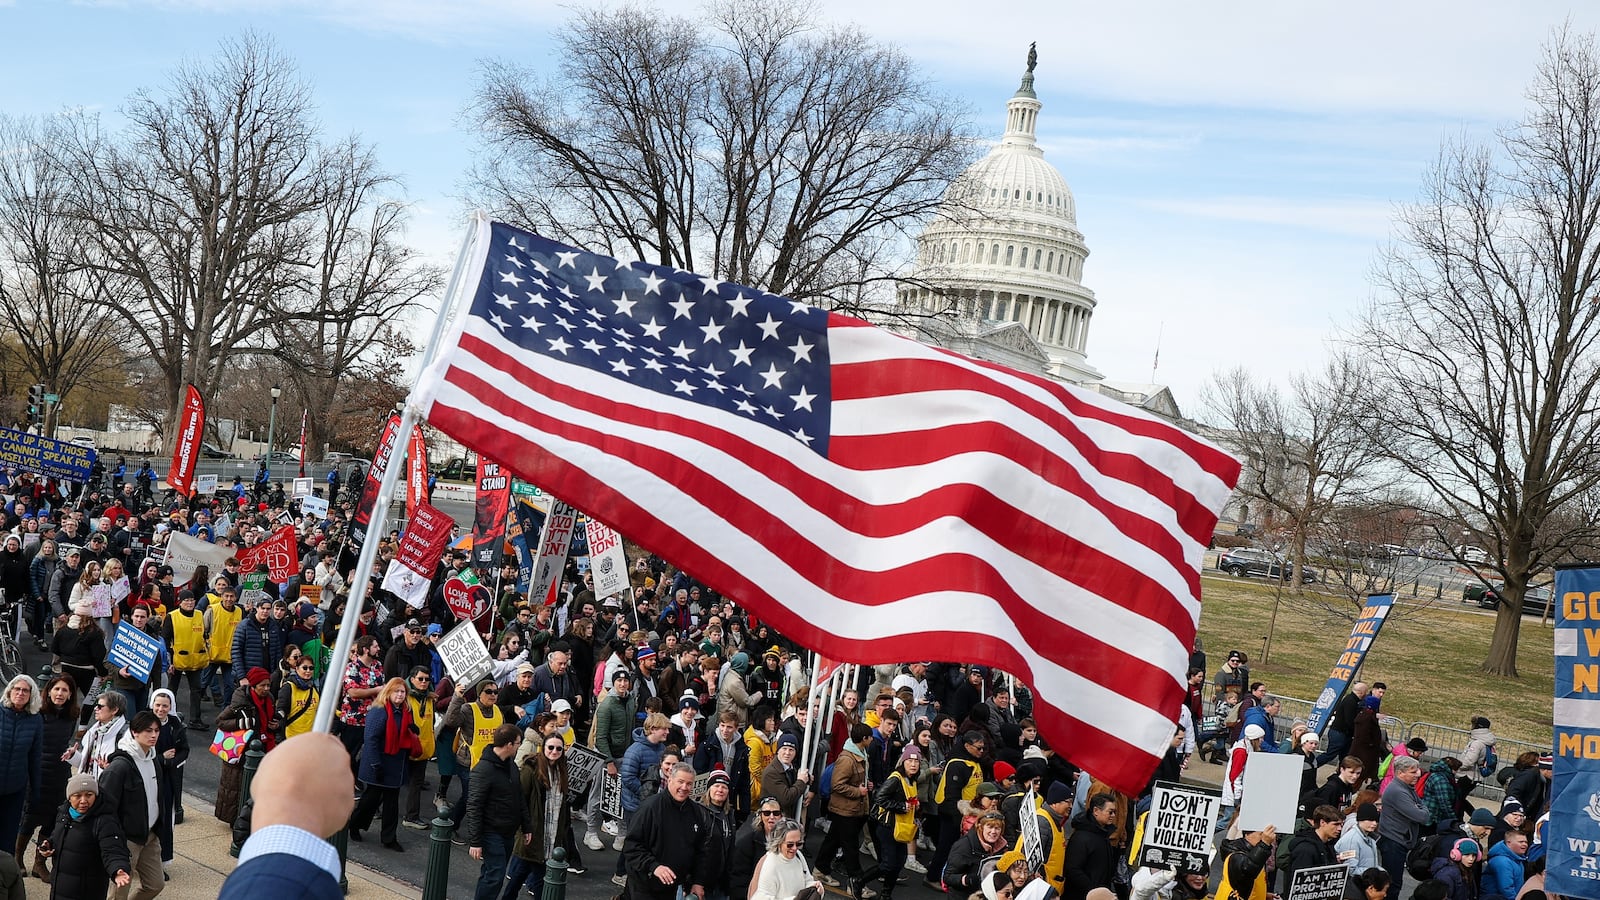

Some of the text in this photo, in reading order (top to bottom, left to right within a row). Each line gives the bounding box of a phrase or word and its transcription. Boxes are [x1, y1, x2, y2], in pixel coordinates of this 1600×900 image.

[187, 412, 198, 440] CENTER
[0, 430, 88, 458] EAK UP FOR THOSE
[2, 442, 91, 468] CANNOT SPEAK FOR
[484, 464, 499, 476] WE
[482, 477, 506, 490] STAND
[415, 516, 434, 531] PERSON
[418, 509, 432, 520] EVERY
[408, 532, 430, 548] CHOSEN
[592, 535, 619, 558] ION!
[404, 543, 422, 557] LOVED
[401, 554, 430, 574] NECESSARY
[448, 588, 468, 600] LOVE
[450, 598, 472, 610] BOTH
[1562, 592, 1600, 620] GO
[117, 633, 154, 659] RIGHTS BEGIN
[128, 630, 148, 647] HUMAN
[114, 644, 149, 668] CONCEPTION
[448, 638, 478, 666] VOTE FOR
[1340, 652, 1360, 667] BE
[452, 648, 485, 676] VIOLENCE
[567, 763, 592, 782] OTE FOR
[1160, 792, 1212, 816] DON'T
[1158, 811, 1208, 834] VOTE FOR
[1154, 828, 1206, 851] VIOLENCE
[1304, 874, 1320, 883] AM
[1324, 871, 1344, 880] THE
[1570, 869, 1600, 880] RES
[1292, 889, 1340, 900] GENERATION
[1293, 879, 1344, 894] PRO-LIFE
